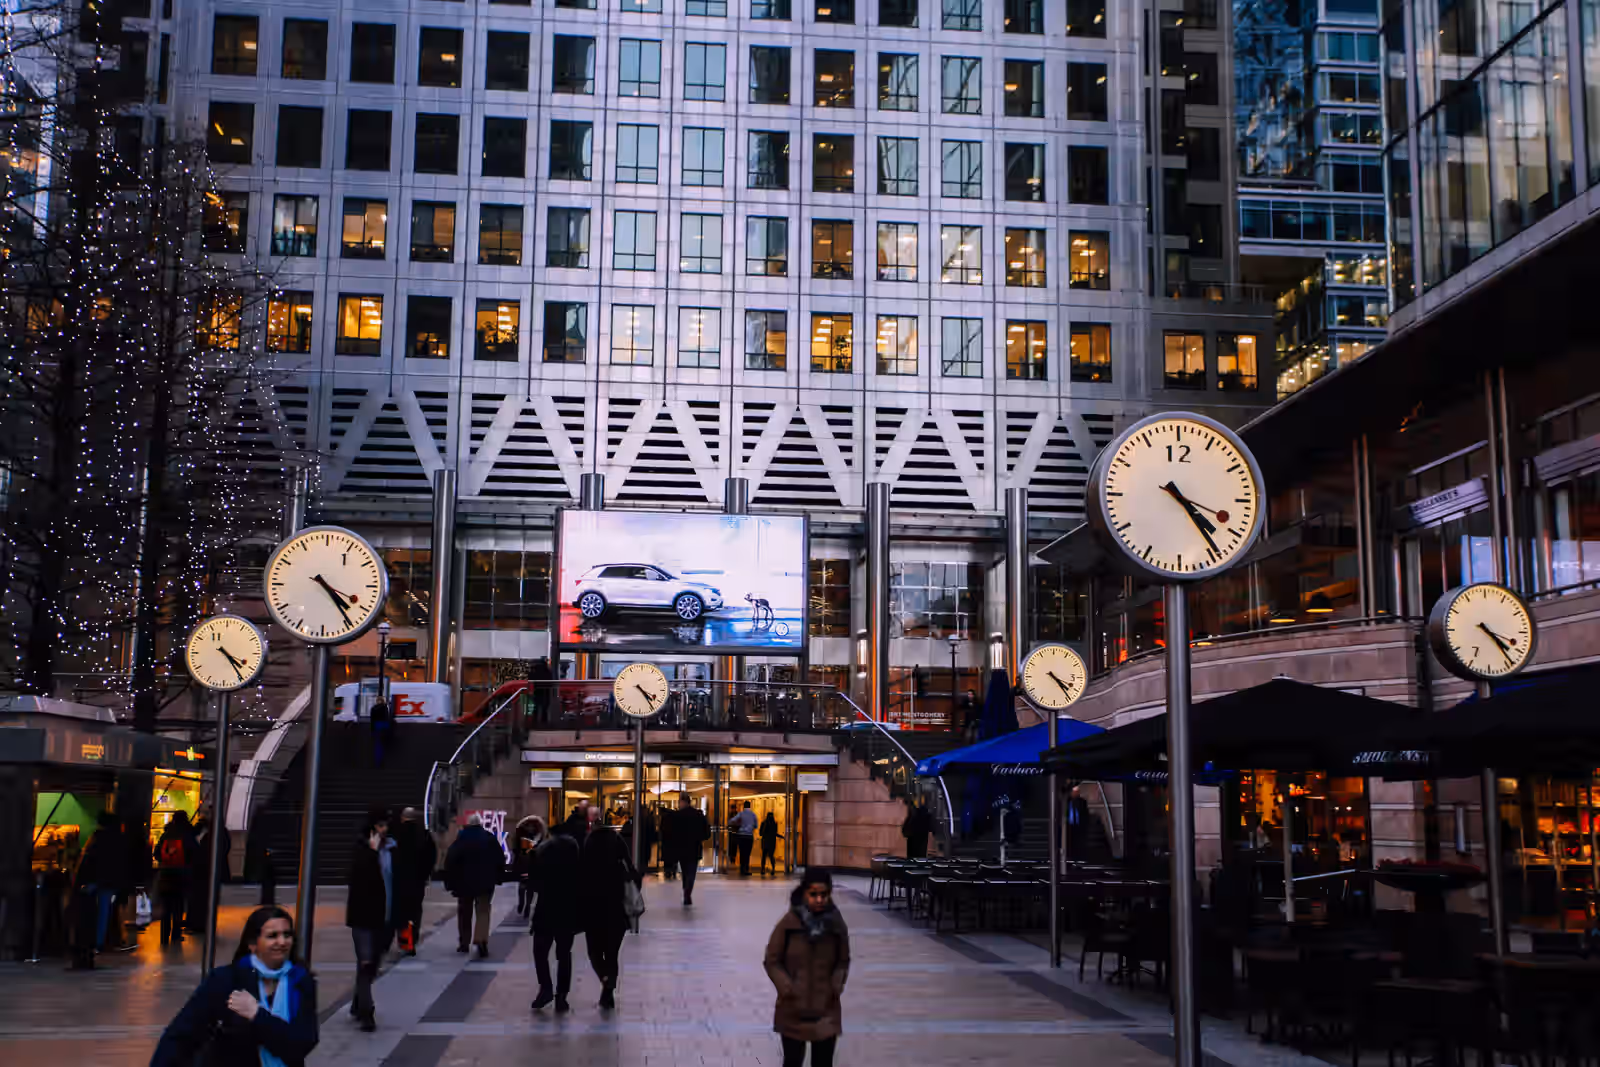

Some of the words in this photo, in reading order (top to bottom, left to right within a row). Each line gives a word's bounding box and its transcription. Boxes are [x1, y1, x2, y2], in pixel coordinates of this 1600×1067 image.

[1166, 444, 1191, 463] 12
[341, 553, 347, 566] 1
[211, 632, 221, 641] 11
[1471, 646, 1480, 658] 7
[1070, 673, 1076, 682] 3
